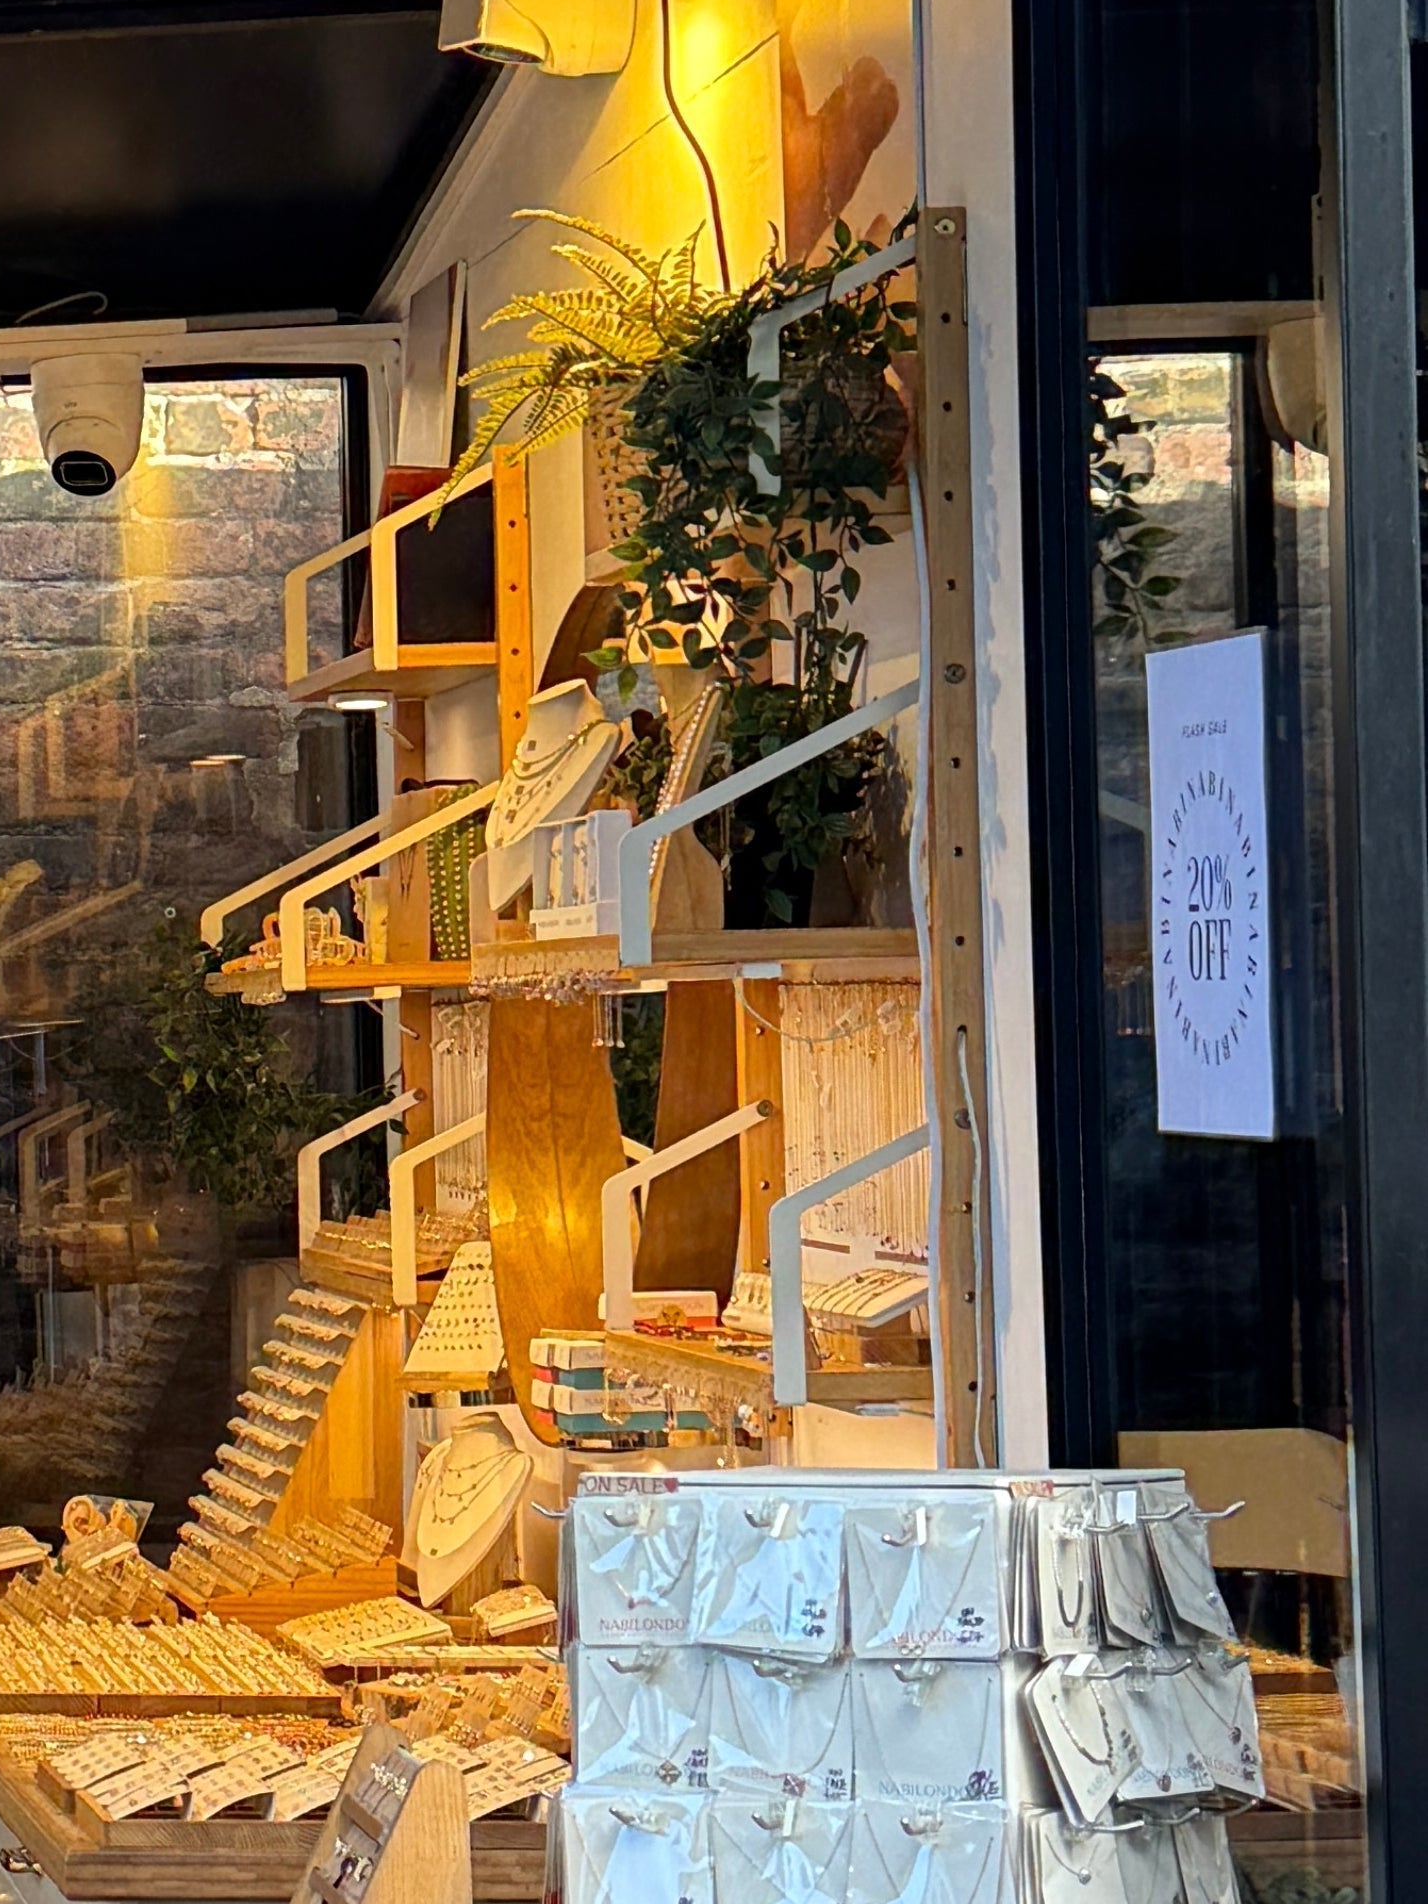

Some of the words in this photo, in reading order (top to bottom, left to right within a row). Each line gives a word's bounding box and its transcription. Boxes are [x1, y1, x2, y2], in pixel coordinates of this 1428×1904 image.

[1187, 853, 1233, 913] 20%
[1189, 918, 1232, 981] OFF
[583, 1475, 611, 1493] ON
[616, 1476, 665, 1494] SALE
